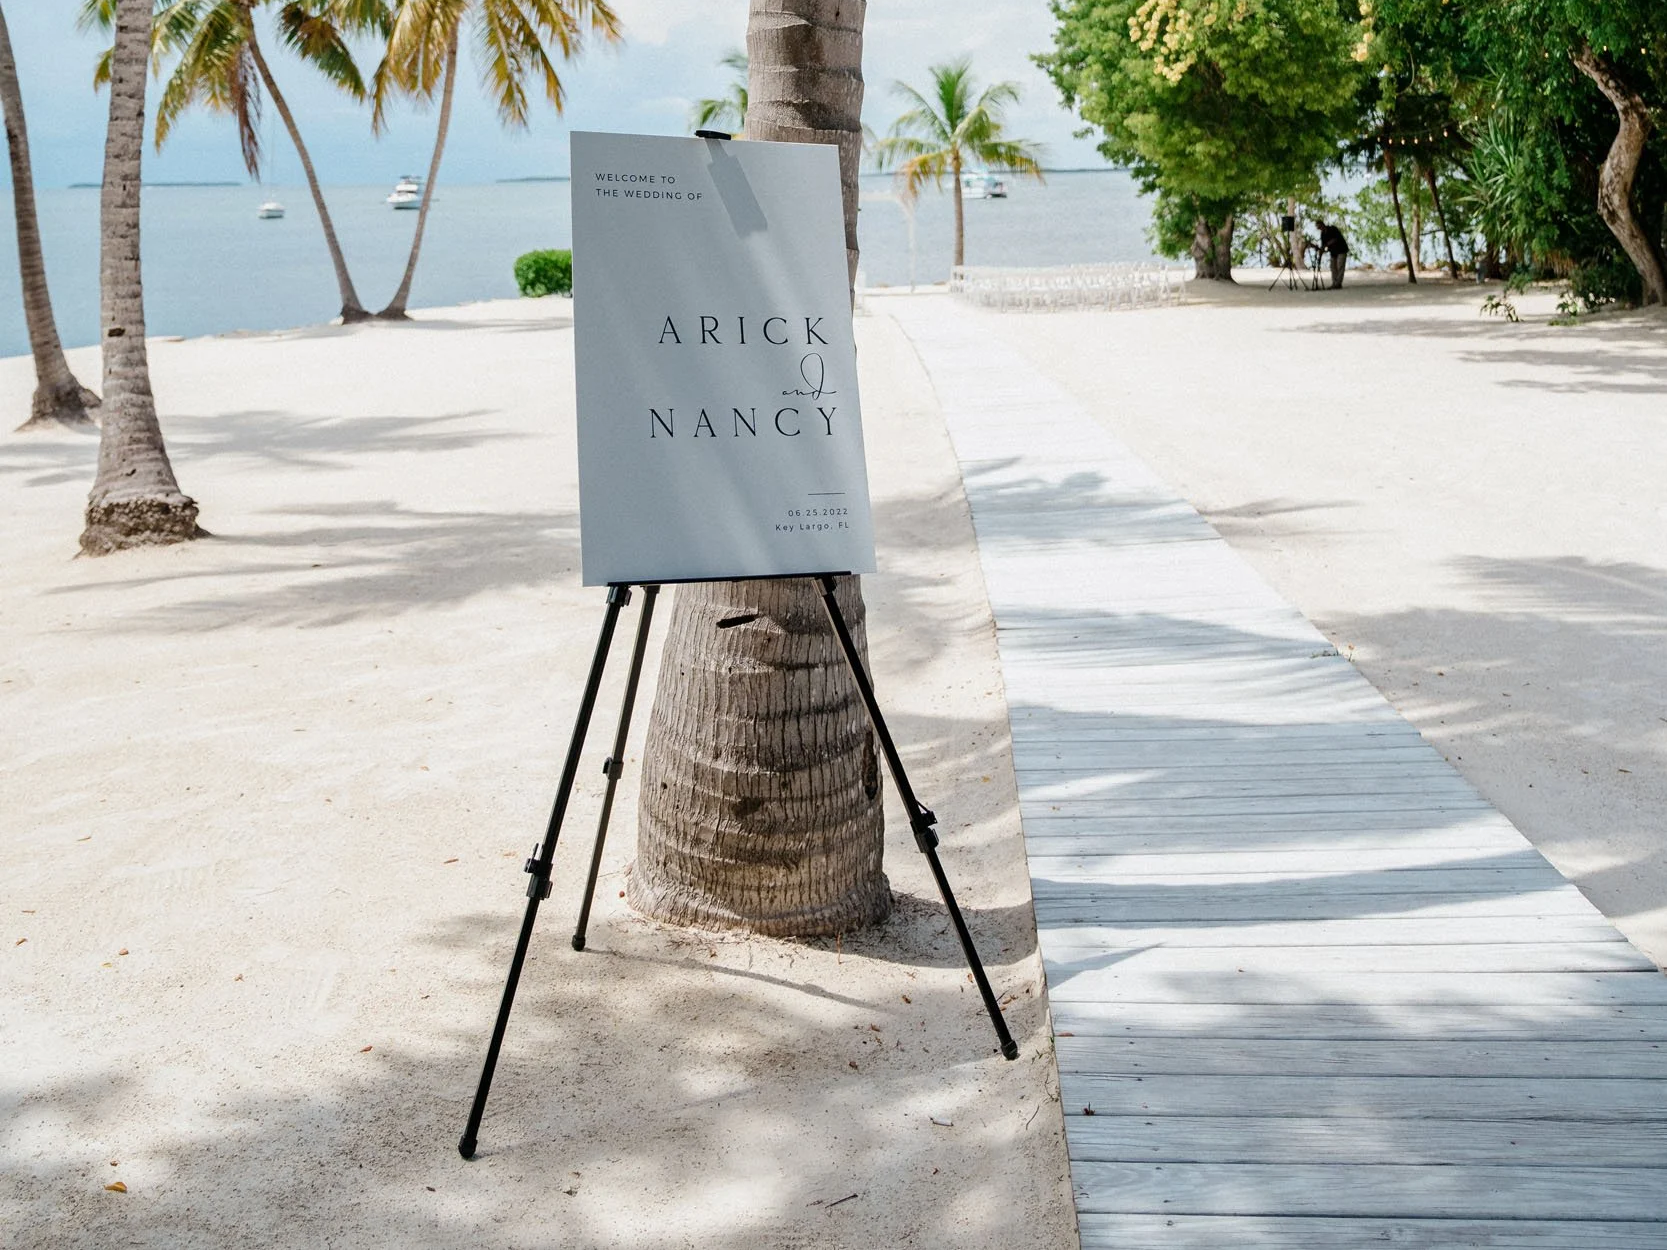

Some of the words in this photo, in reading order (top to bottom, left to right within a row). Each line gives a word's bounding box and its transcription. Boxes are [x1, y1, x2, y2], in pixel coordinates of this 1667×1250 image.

[595, 173, 655, 183] WELCOME
[661, 175, 676, 184] TO
[595, 188, 619, 197] THE
[624, 190, 682, 200] WEDDING
[687, 192, 703, 200] OF
[658, 315, 829, 345] ARICK
[782, 352, 837, 400] and
[648, 407, 837, 438] NANCY
[788, 508, 848, 517] 06.25.2022
[775, 524, 794, 532] Key
[838, 521, 849, 529] FL
